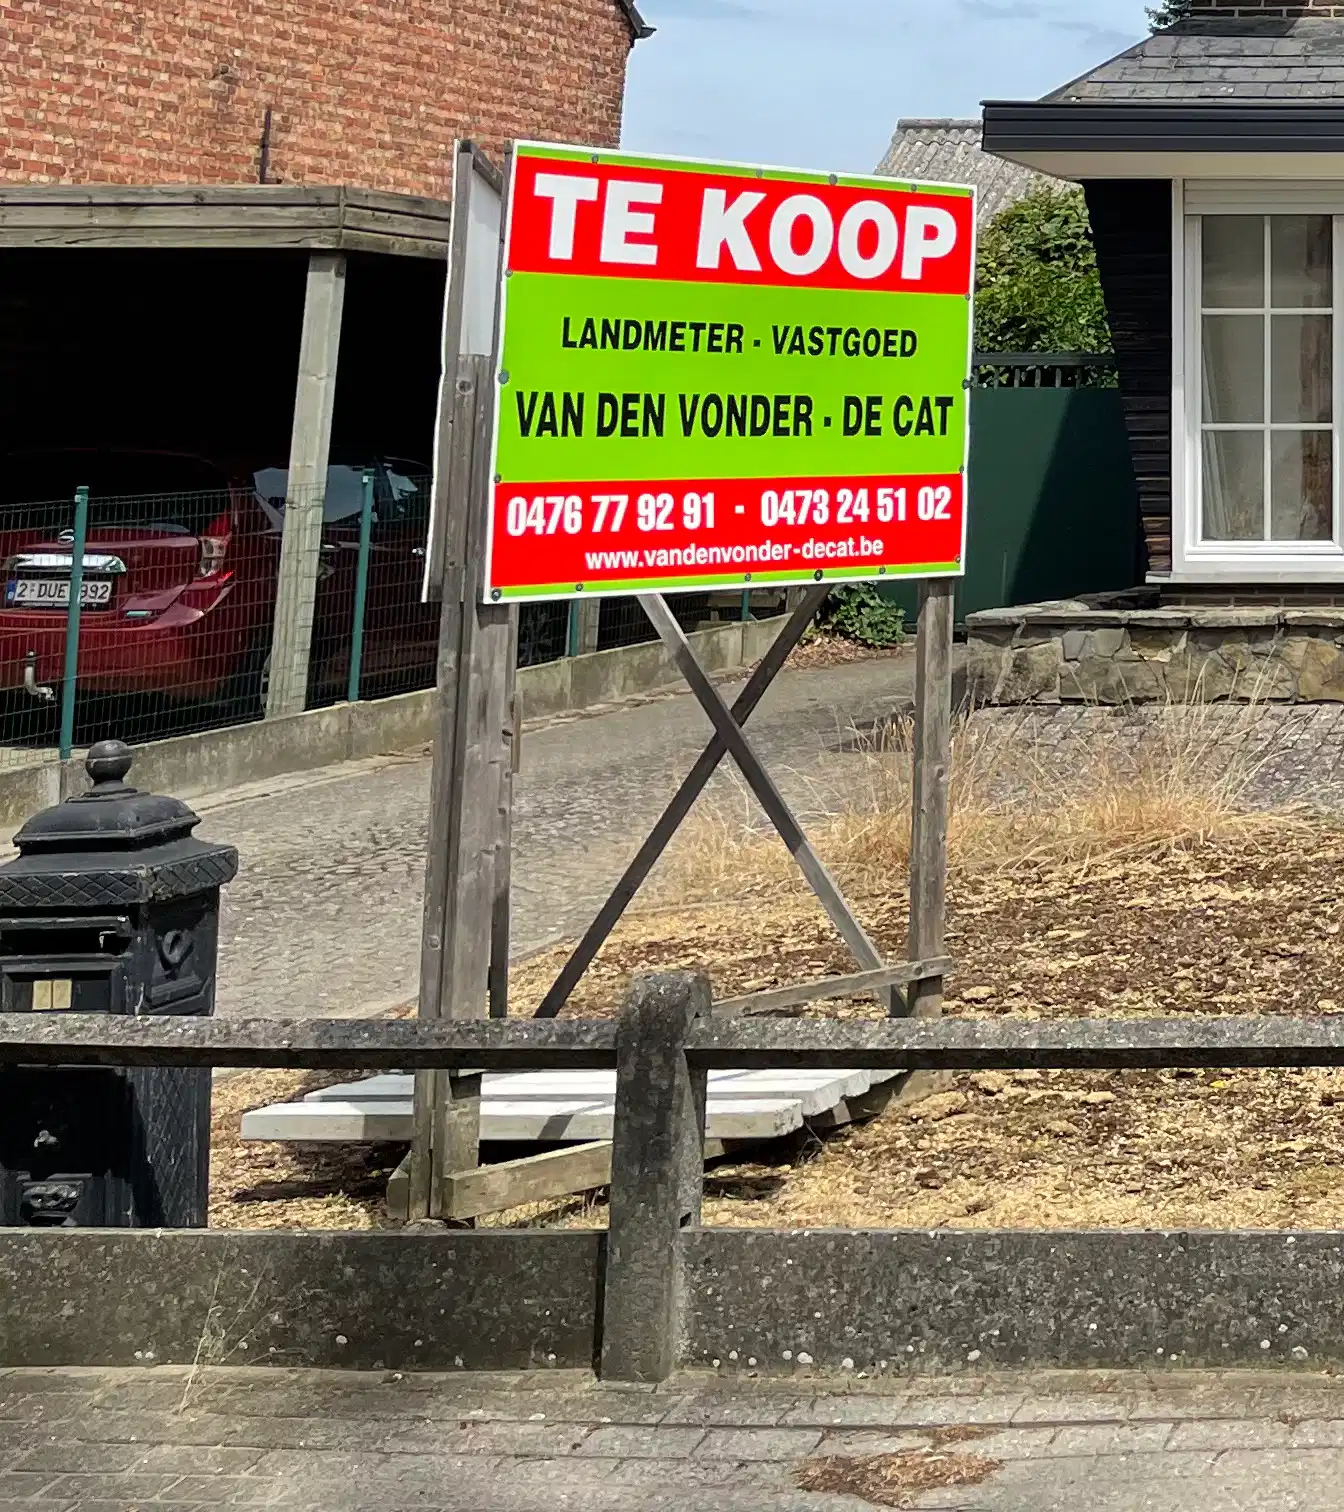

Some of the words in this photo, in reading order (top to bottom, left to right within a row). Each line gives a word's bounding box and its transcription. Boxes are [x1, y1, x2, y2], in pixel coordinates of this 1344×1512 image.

[534, 173, 663, 264] TE
[697, 188, 956, 279] KOOP
[563, 317, 743, 353] LANDMETER
[772, 325, 917, 358] VASTGOED
[516, 392, 584, 437] VAN
[597, 393, 666, 437] DEN
[678, 394, 812, 437] VONDER
[843, 396, 882, 436] DE
[894, 396, 954, 436] CAT
[507, 494, 582, 536] 0476
[592, 494, 629, 532] 77
[637, 492, 674, 532] 92
[683, 492, 715, 530] 91
[761, 489, 829, 527] 0473
[837, 488, 870, 524] 24
[877, 487, 906, 523] 51
[917, 485, 952, 521] 02
[585, 537, 884, 570] www.vandenvonder-decat.be
